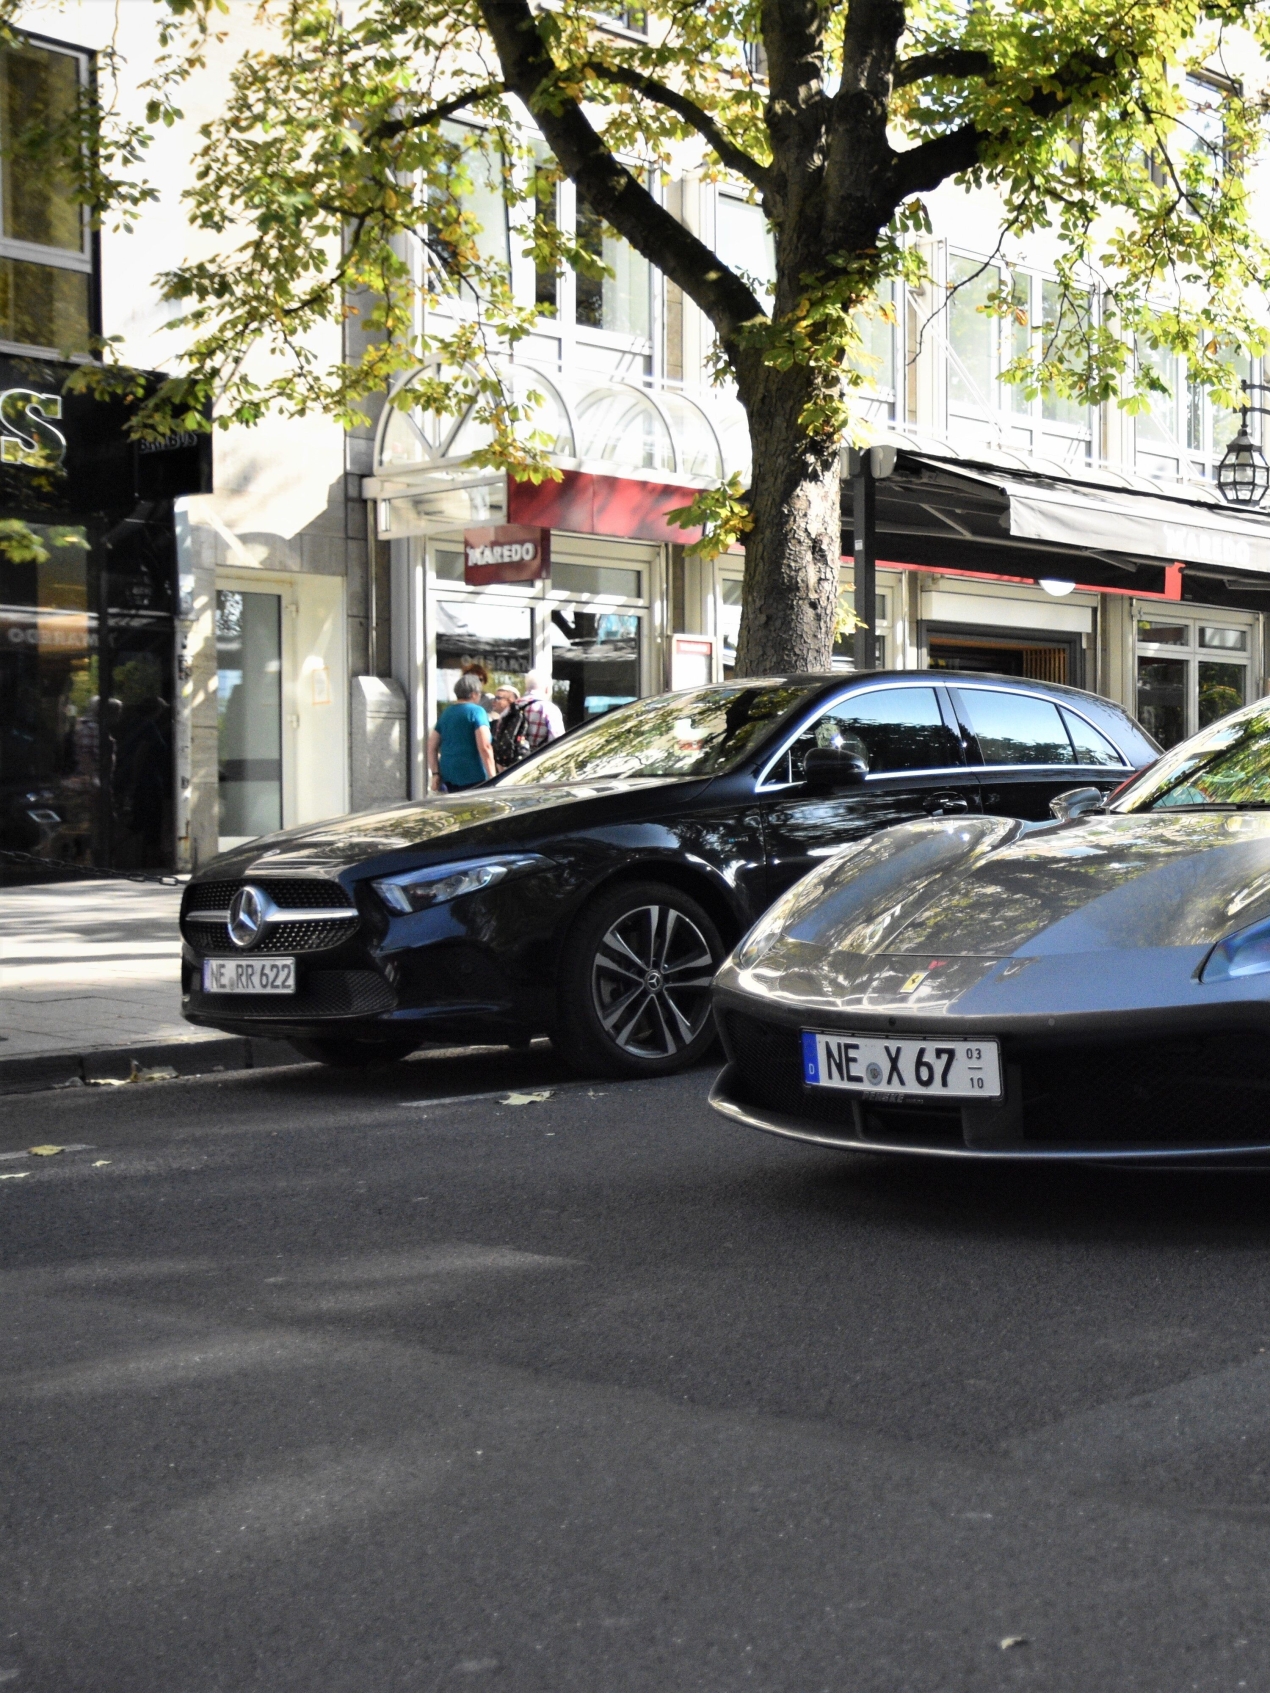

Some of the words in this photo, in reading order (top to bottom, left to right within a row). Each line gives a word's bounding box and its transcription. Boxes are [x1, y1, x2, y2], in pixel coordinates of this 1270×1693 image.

[467, 542, 536, 567] MAREDO
[1163, 524, 1250, 562] MAREDO
[211, 963, 227, 988] NE
[235, 964, 255, 989] RR
[259, 963, 292, 989] 622
[825, 1040, 864, 1083] NE
[884, 1045, 906, 1086] X
[915, 1046, 956, 1088] 67
[966, 1048, 982, 1060] 03
[969, 1077, 984, 1089] 10
